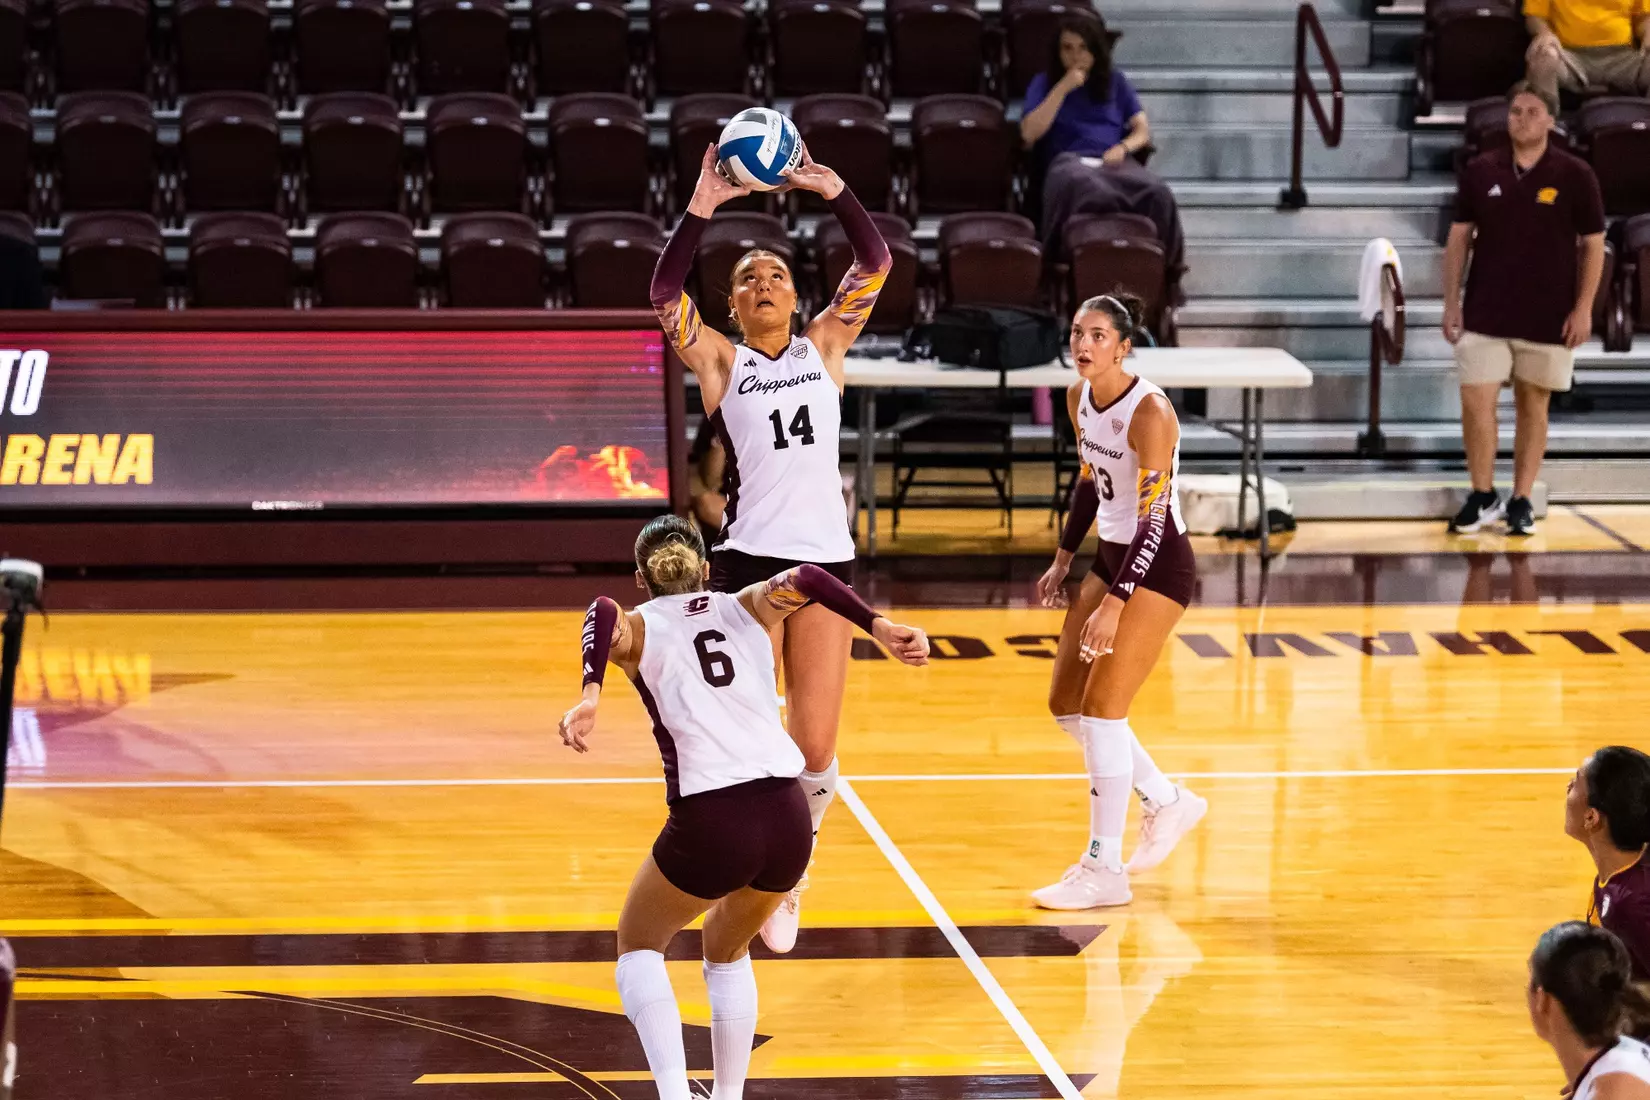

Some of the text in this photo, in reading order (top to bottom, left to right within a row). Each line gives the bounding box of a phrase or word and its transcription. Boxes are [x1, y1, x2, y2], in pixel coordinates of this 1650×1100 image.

[738, 371, 821, 395] Chippewas
[768, 404, 815, 450] 14
[0, 434, 154, 485] RENA
[1130, 503, 1166, 578] CHIPPEWAS
[693, 628, 736, 688] 6
